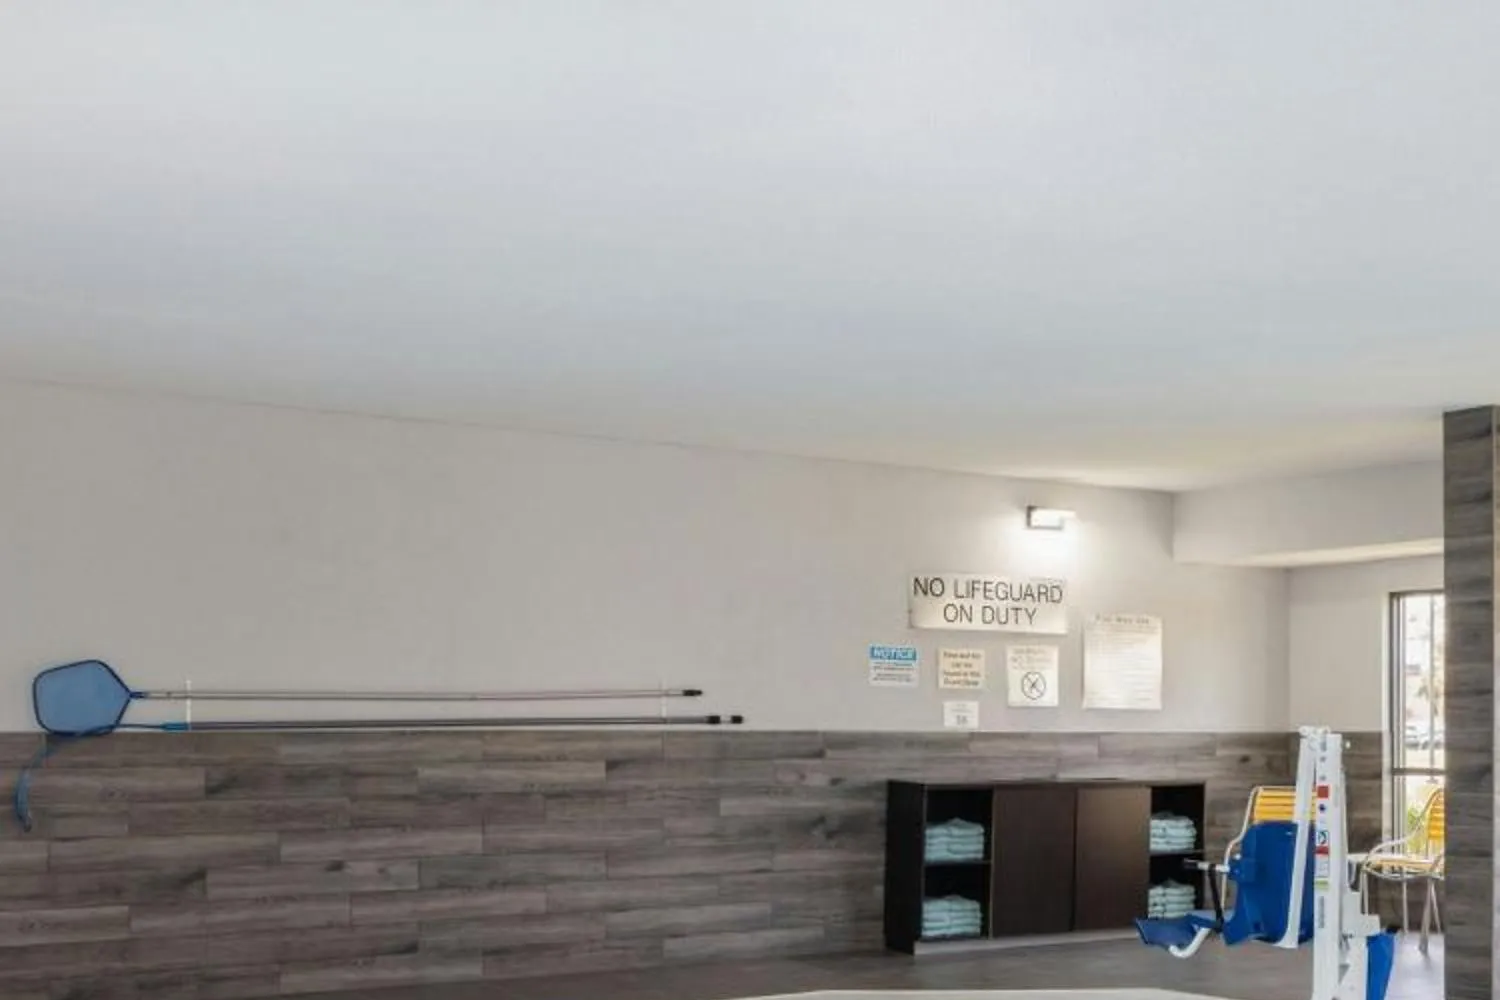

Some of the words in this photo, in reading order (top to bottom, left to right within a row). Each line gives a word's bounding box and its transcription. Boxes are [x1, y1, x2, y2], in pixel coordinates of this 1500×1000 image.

[913, 576, 945, 597] NO
[953, 579, 1063, 604] LIFEGUARD
[943, 603, 973, 623] ON
[981, 605, 1037, 625] DUTY
